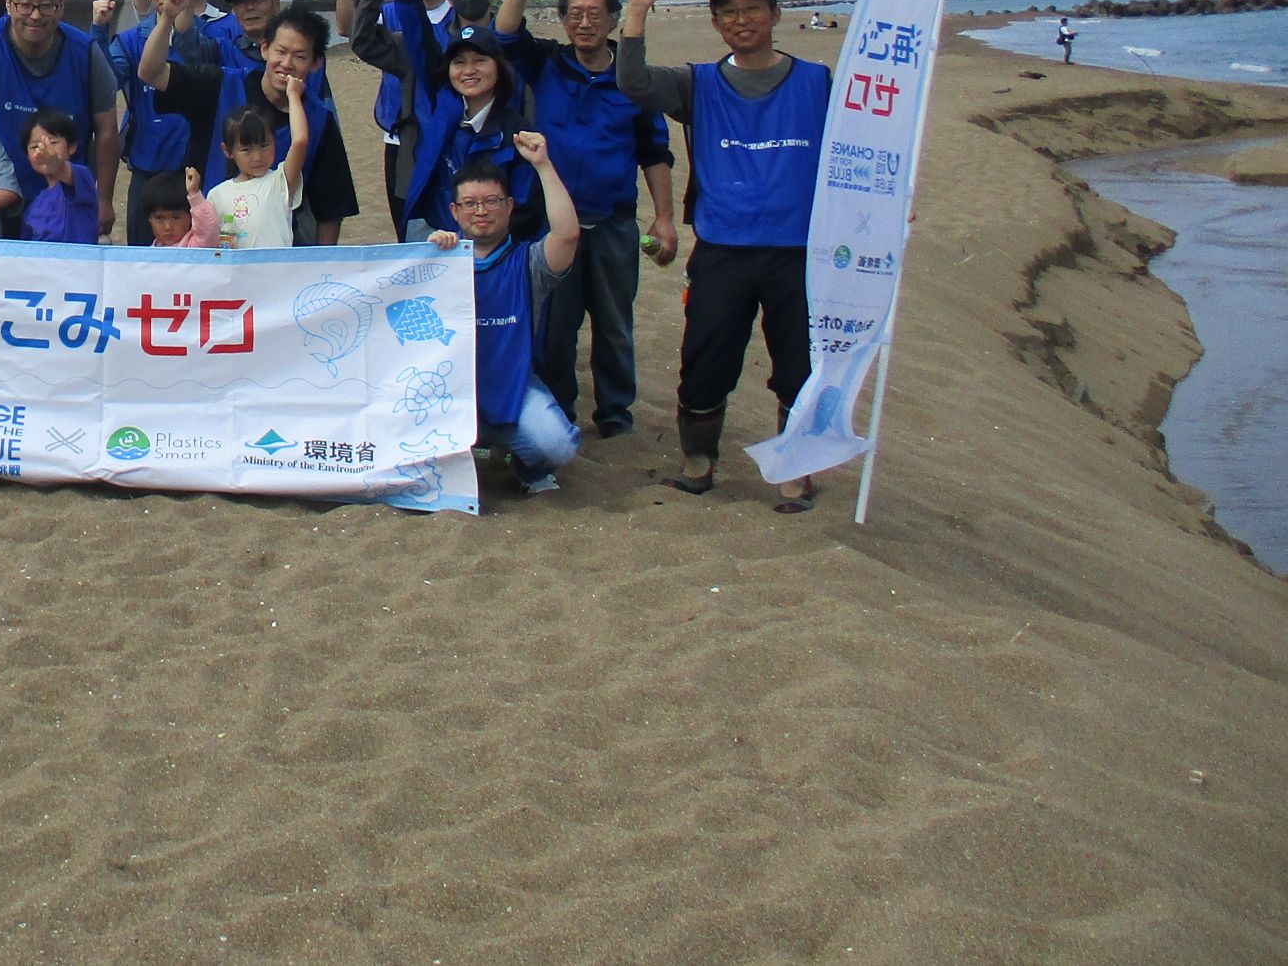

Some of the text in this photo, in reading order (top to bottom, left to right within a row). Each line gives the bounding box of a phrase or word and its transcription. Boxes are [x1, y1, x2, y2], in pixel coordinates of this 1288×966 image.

[155, 432, 222, 449] Plastics
[154, 447, 207, 460] Smart
[303, 439, 376, 463] 環境省
[242, 455, 285, 469] Ministry
[287, 459, 299, 468] of
[300, 460, 315, 470] the
